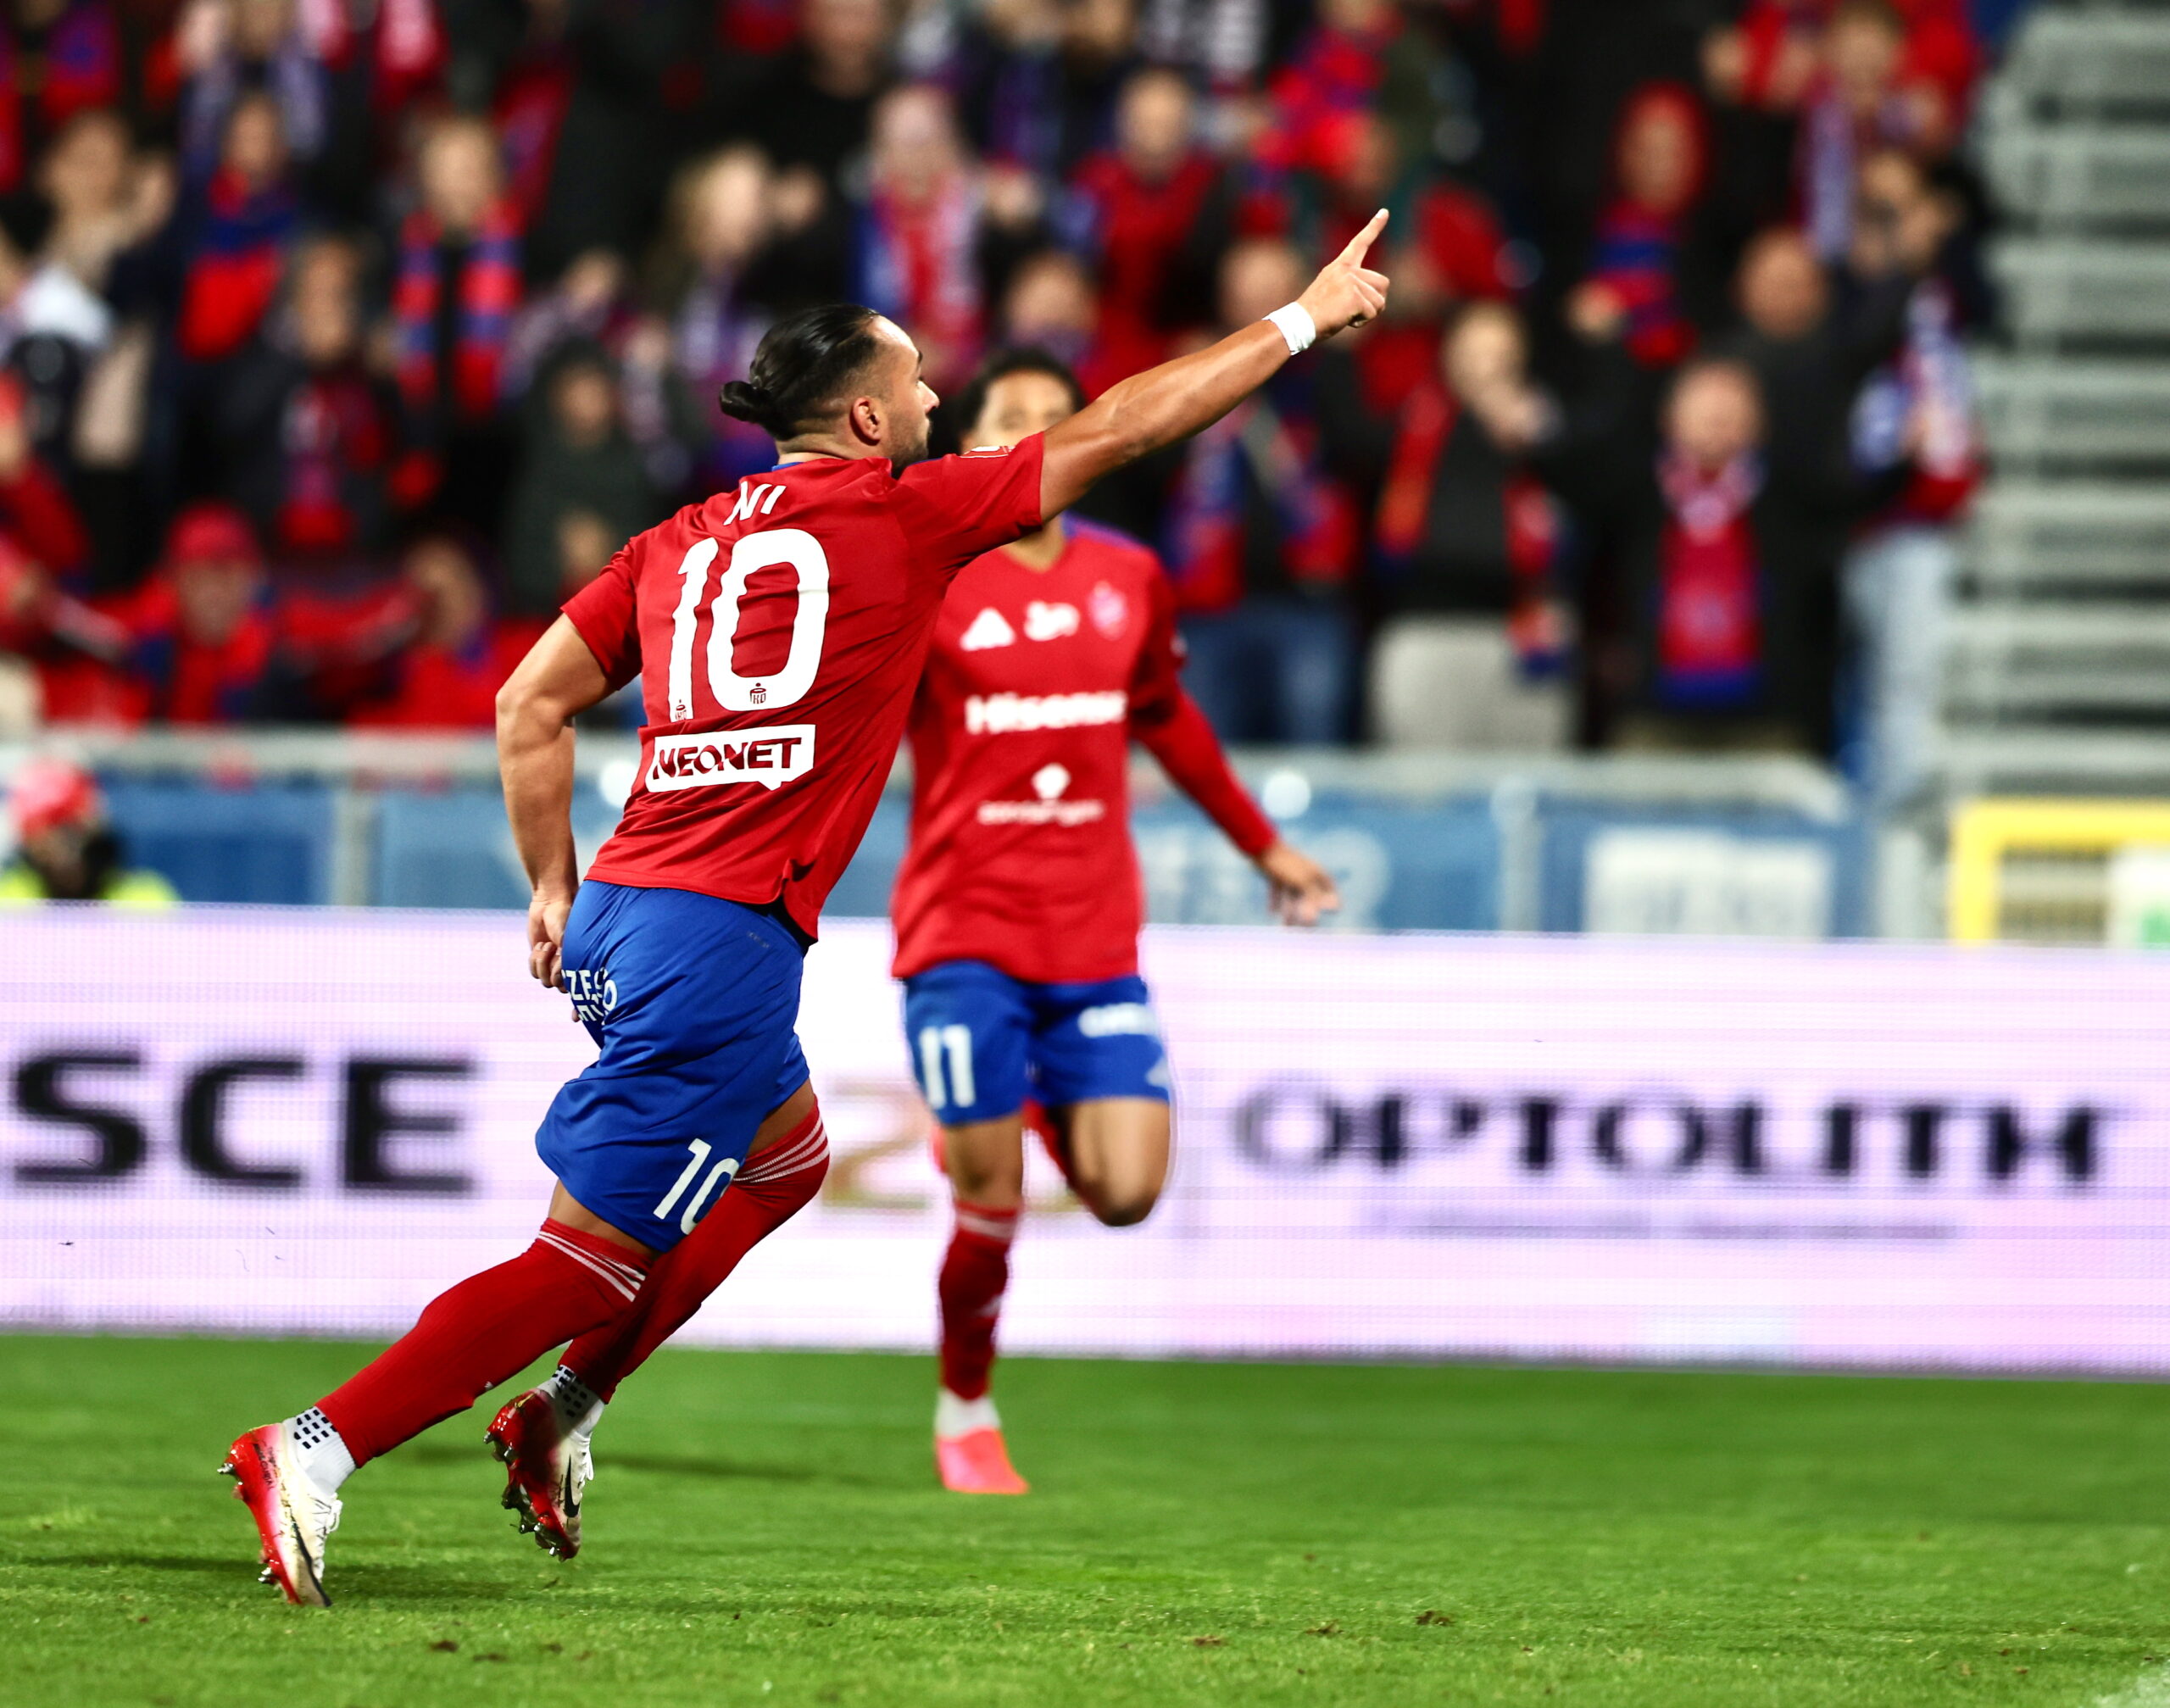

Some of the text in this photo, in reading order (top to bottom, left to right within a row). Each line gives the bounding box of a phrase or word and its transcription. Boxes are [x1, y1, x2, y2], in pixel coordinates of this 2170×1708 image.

[668, 528, 830, 722] 10
[652, 737, 802, 781] NEONET
[918, 1022, 976, 1110] 11
[12, 1049, 478, 1195] SCE
[653, 1137, 741, 1236] 10
